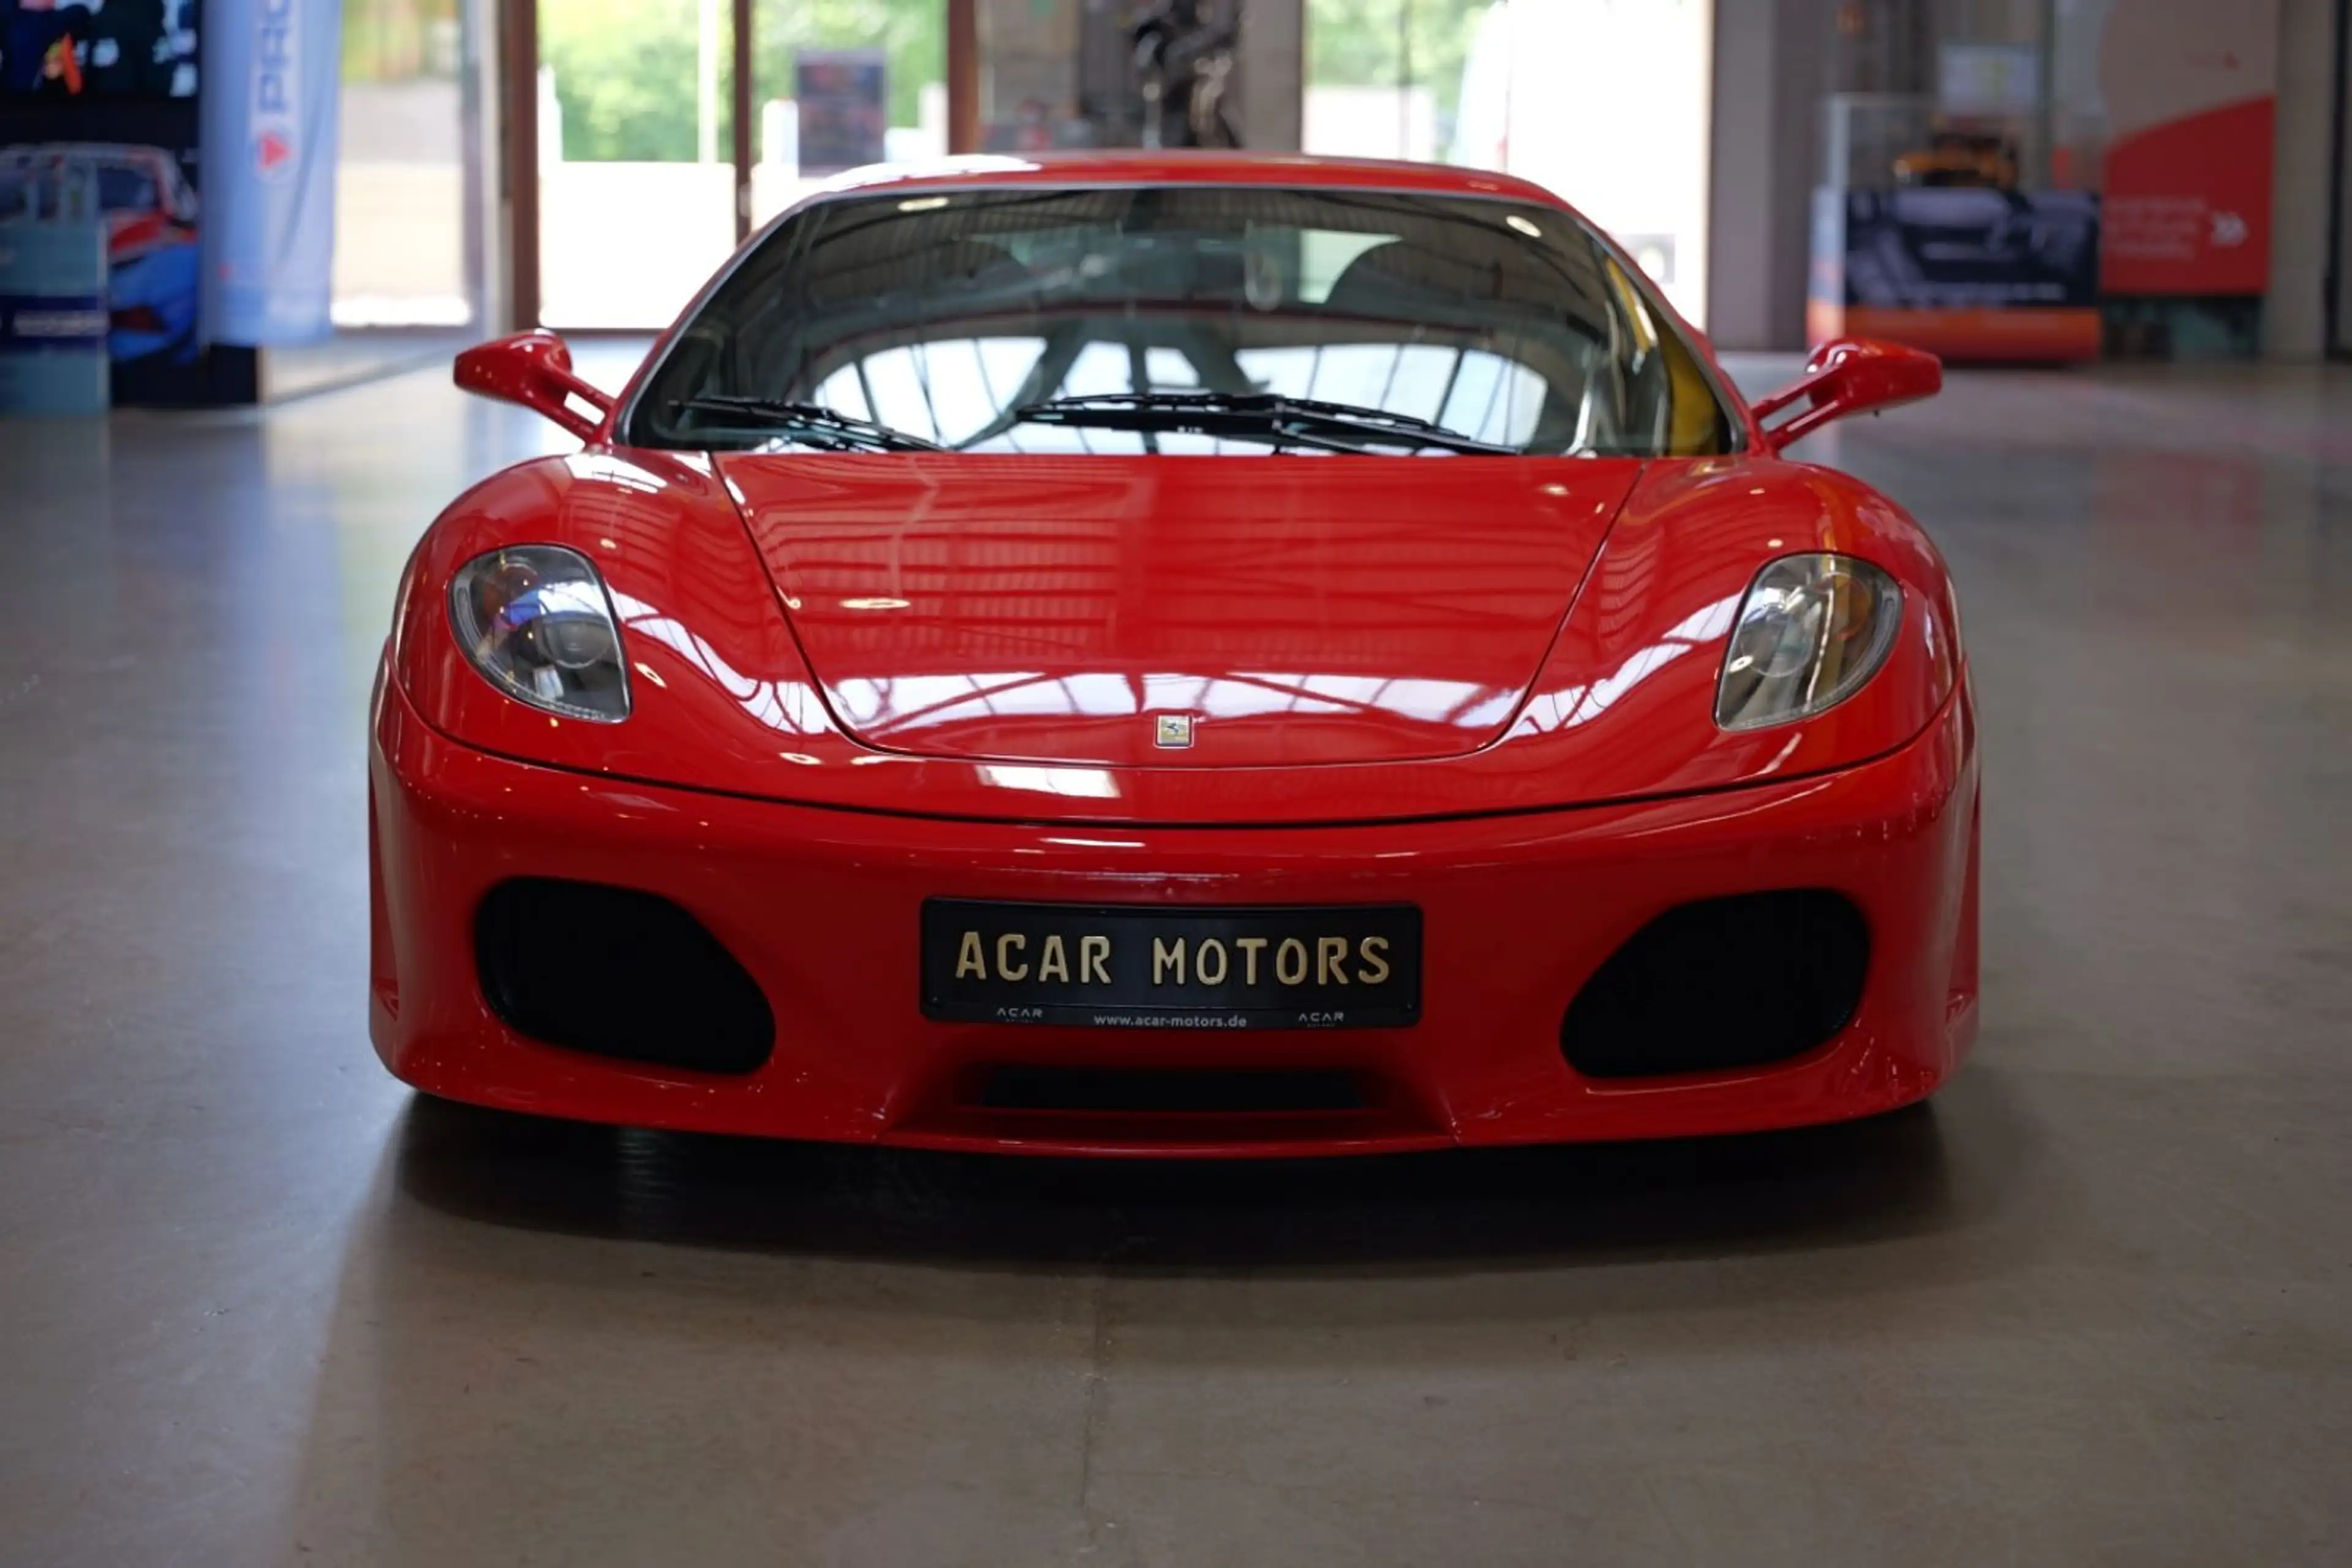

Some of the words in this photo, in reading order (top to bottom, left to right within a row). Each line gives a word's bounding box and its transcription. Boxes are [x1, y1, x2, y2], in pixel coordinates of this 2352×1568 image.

[956, 931, 1112, 984] ACAR
[1153, 936, 1390, 986] MOTORS
[997, 1007, 1042, 1017] ACAR
[1298, 1011, 1344, 1022] ACAR
[1093, 1014, 1248, 1028] www.acar-motors.de
